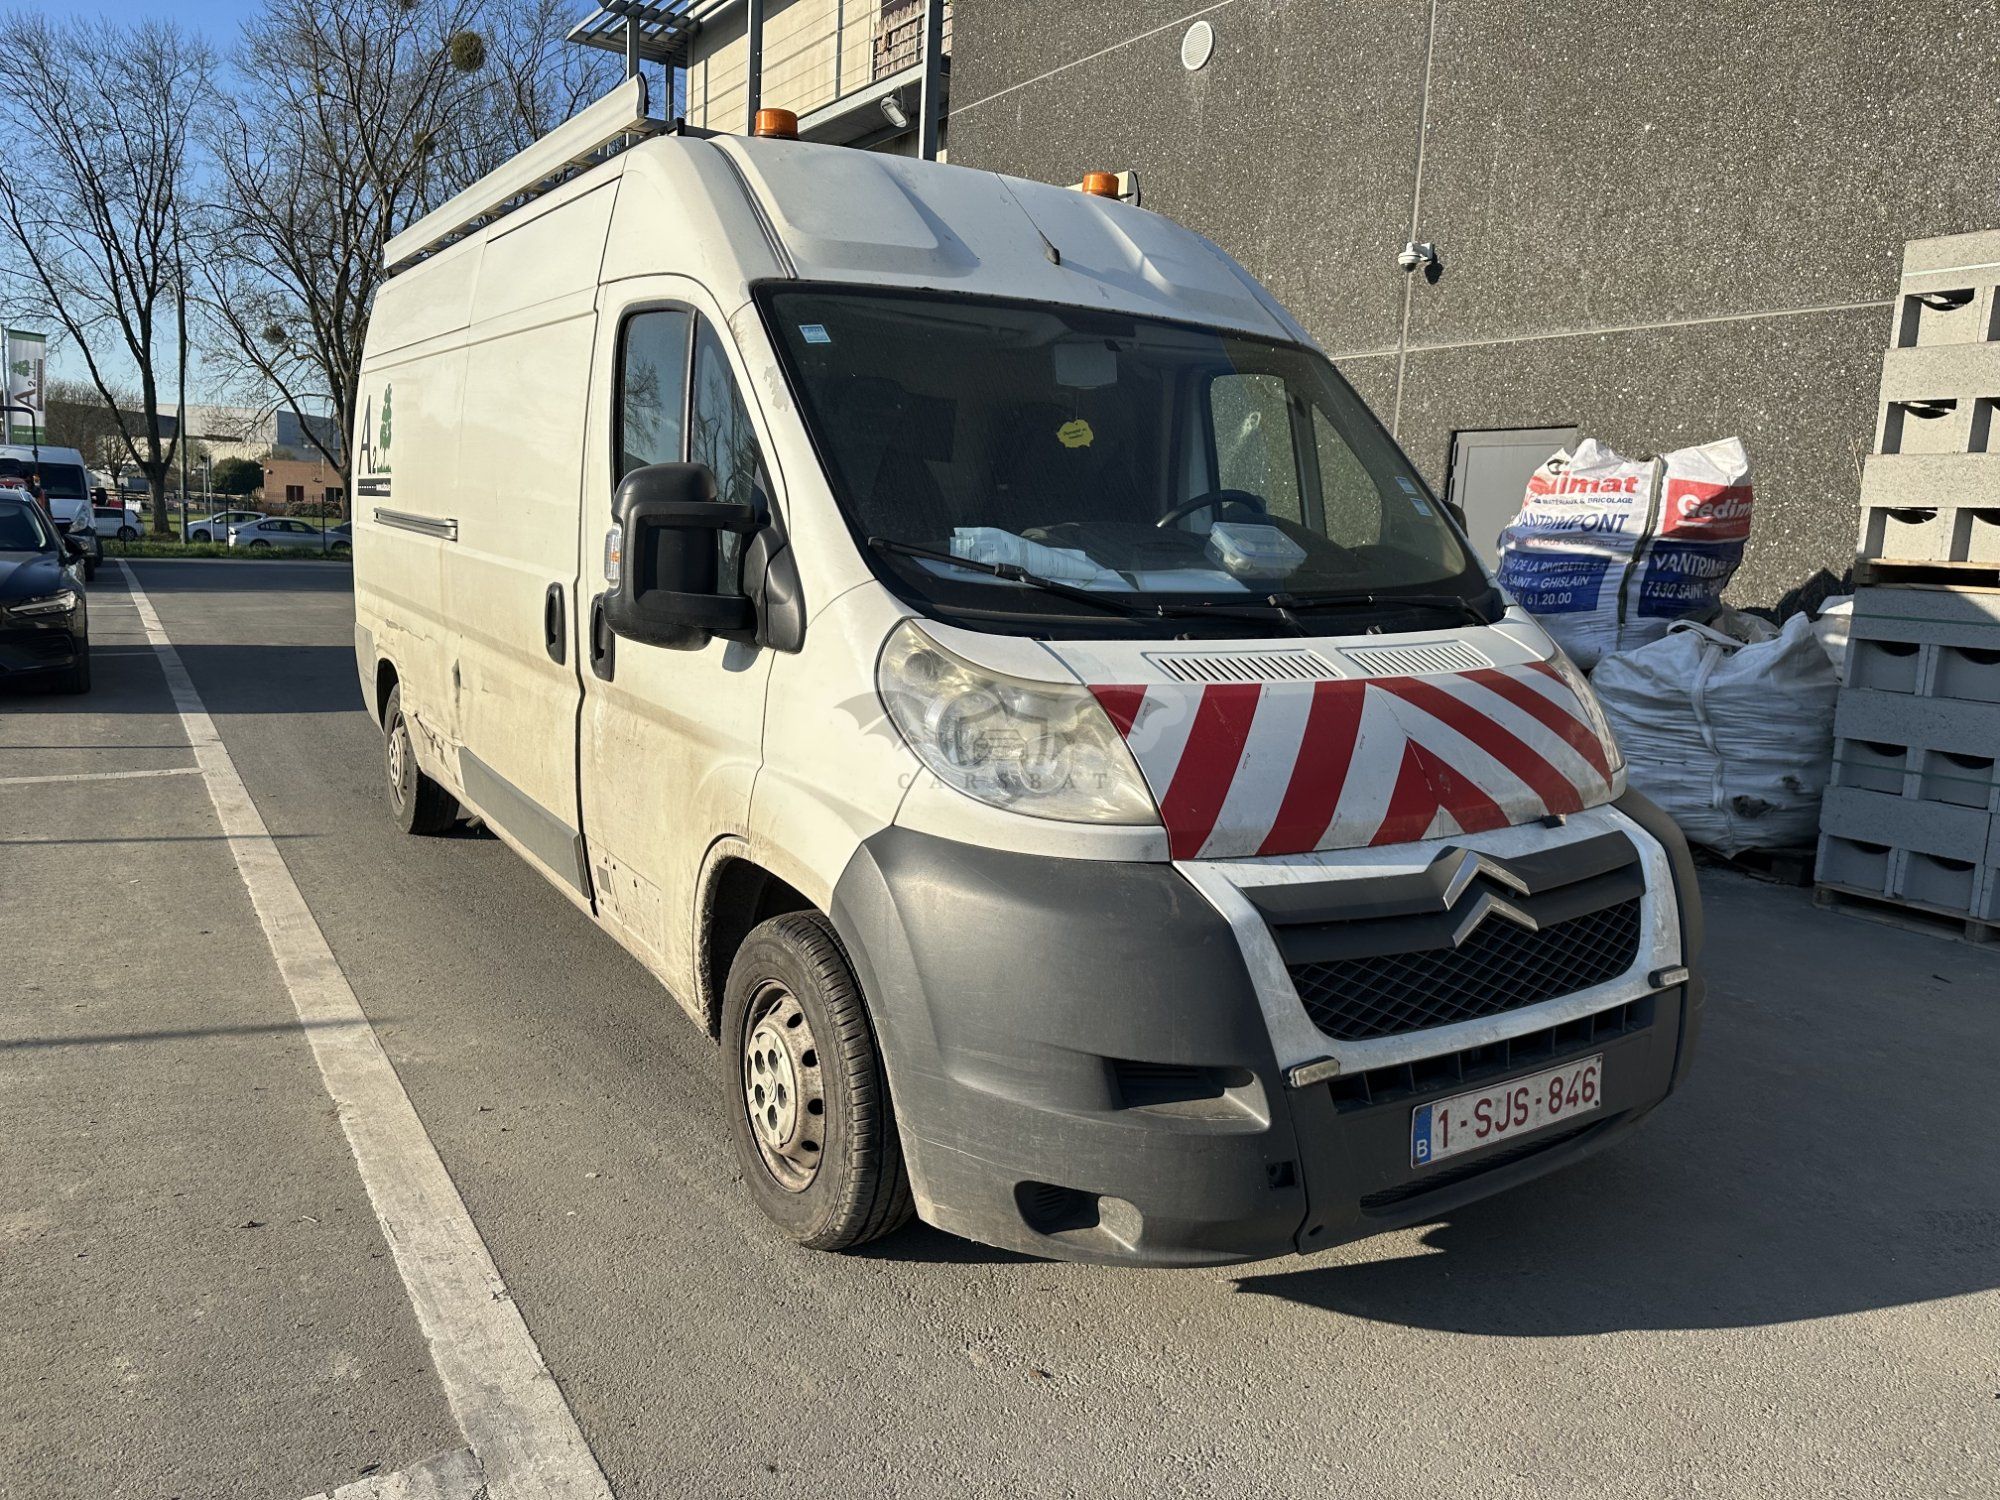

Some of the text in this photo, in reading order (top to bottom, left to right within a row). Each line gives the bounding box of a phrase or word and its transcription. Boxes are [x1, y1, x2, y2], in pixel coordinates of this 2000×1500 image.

[1527, 560, 1539, 573] LA
[1508, 574, 1532, 588] SAINT
[1540, 576, 1590, 589] GHISLAIN
[1645, 581, 1677, 598] 7330
[1527, 592, 1572, 606] 61.20.00
[1438, 1066, 1597, 1149] 1-SJS-846
[1416, 1139, 1428, 1159] B
